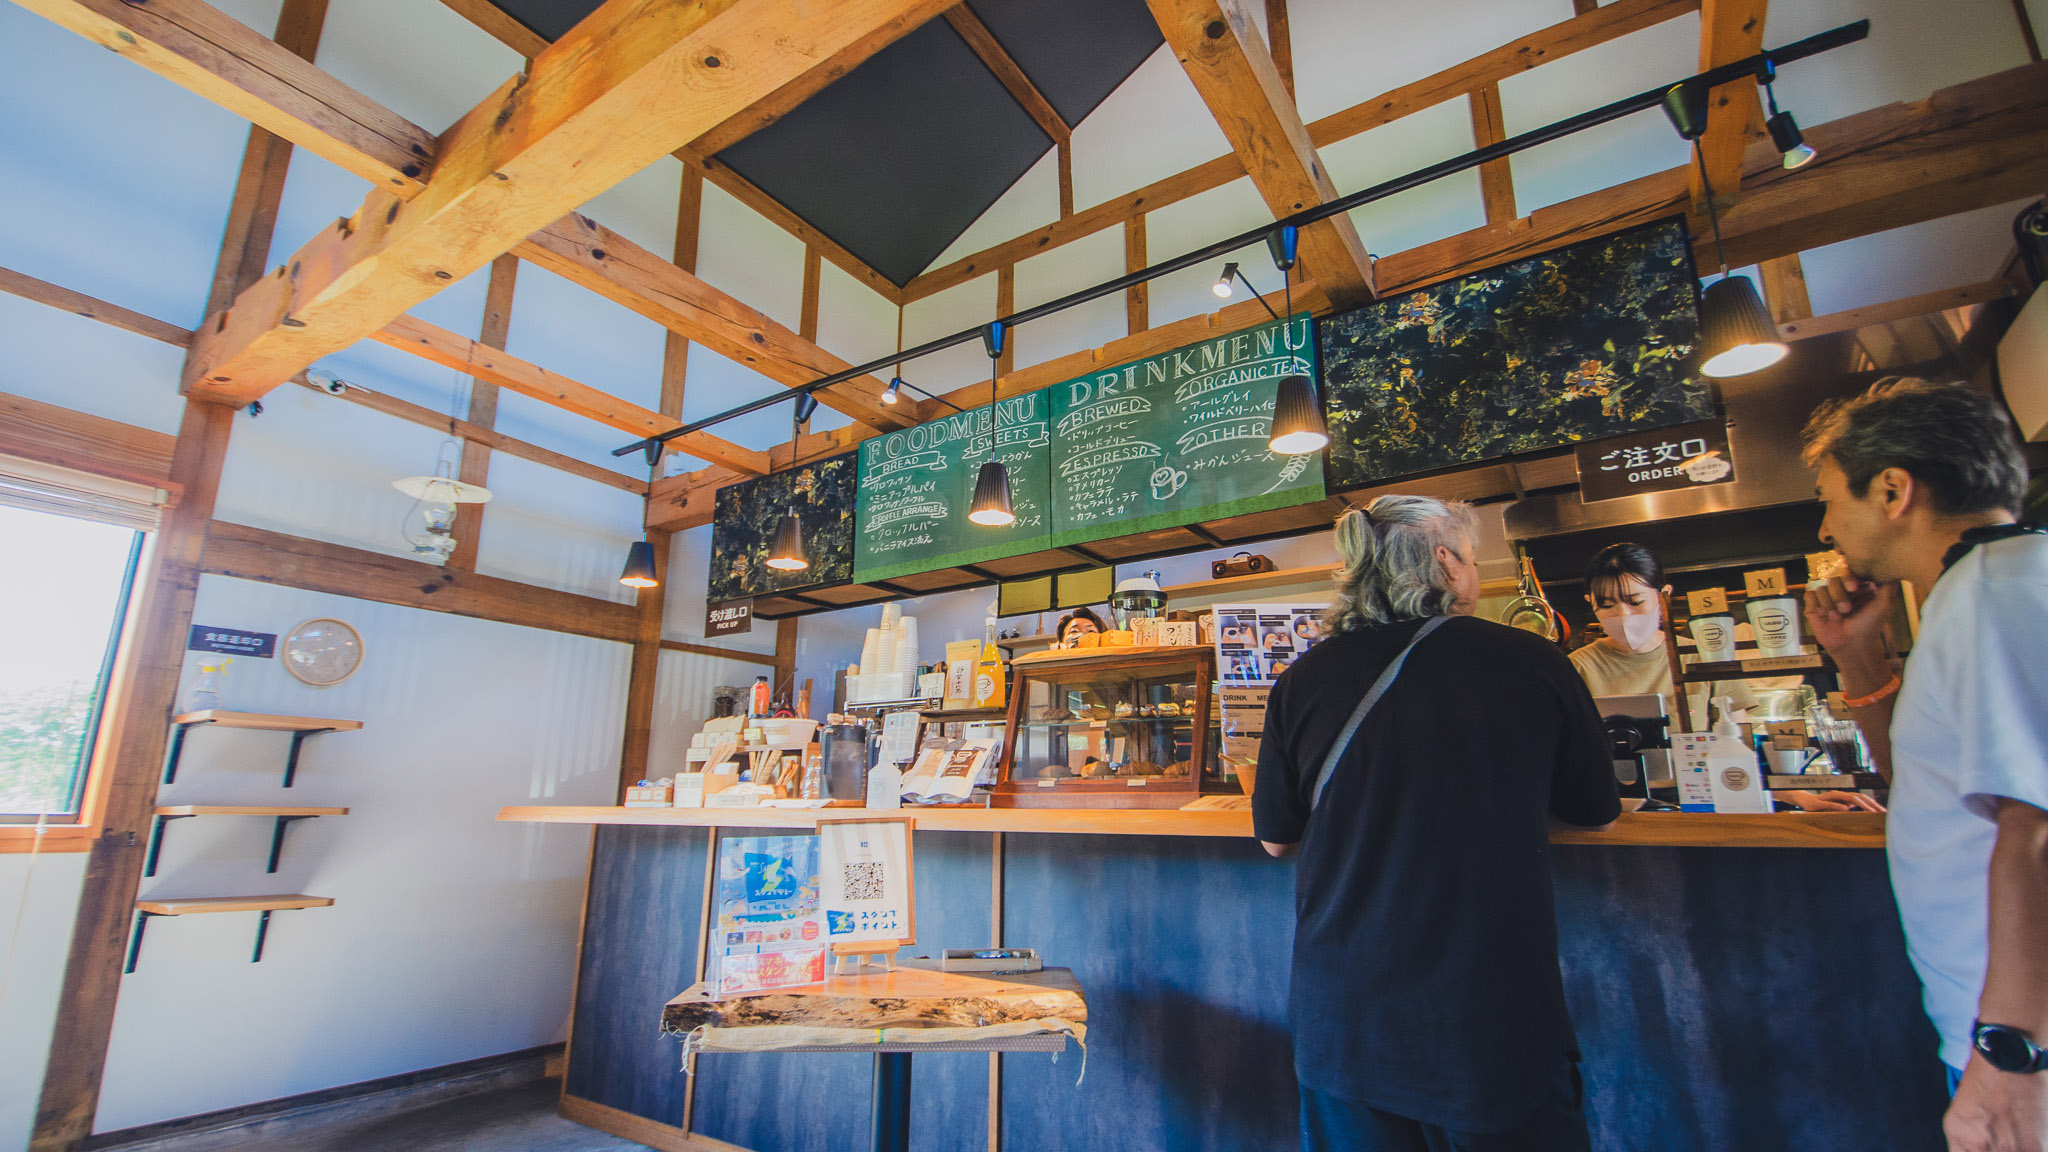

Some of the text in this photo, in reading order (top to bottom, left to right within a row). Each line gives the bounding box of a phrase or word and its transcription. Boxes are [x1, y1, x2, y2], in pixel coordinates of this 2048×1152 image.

[1189, 366, 1267, 396] ORGANIC
[1190, 390, 1252, 410] アールグレイ
[1072, 398, 1140, 428] BREWED
[977, 427, 1029, 449] SWEETS
[1072, 420, 1138, 441] ドリップコーヒー
[1195, 422, 1266, 447] OTHER
[1072, 435, 1136, 453] コールドブリュー
[1074, 445, 1148, 470] ESPRESSO
[1193, 449, 1275, 470] みかんジュース
[1600, 438, 1707, 471] ご注文口
[882, 456, 919, 475] BREAD
[1072, 464, 1123, 482] エスプレッソ
[1627, 466, 1684, 483] ORDER
[873, 475, 912, 492] クロワッサン
[873, 481, 936, 504] ミニアップルパイ
[1073, 475, 1116, 492] アメリカーノ
[1074, 485, 1115, 502] カフェラテ
[902, 504, 938, 517] ARRANGE
[1756, 577, 1774, 590] M
[1702, 596, 1713, 608] S
[709, 606, 747, 623] 受け渡し口
[1223, 694, 1247, 702] DRINK
